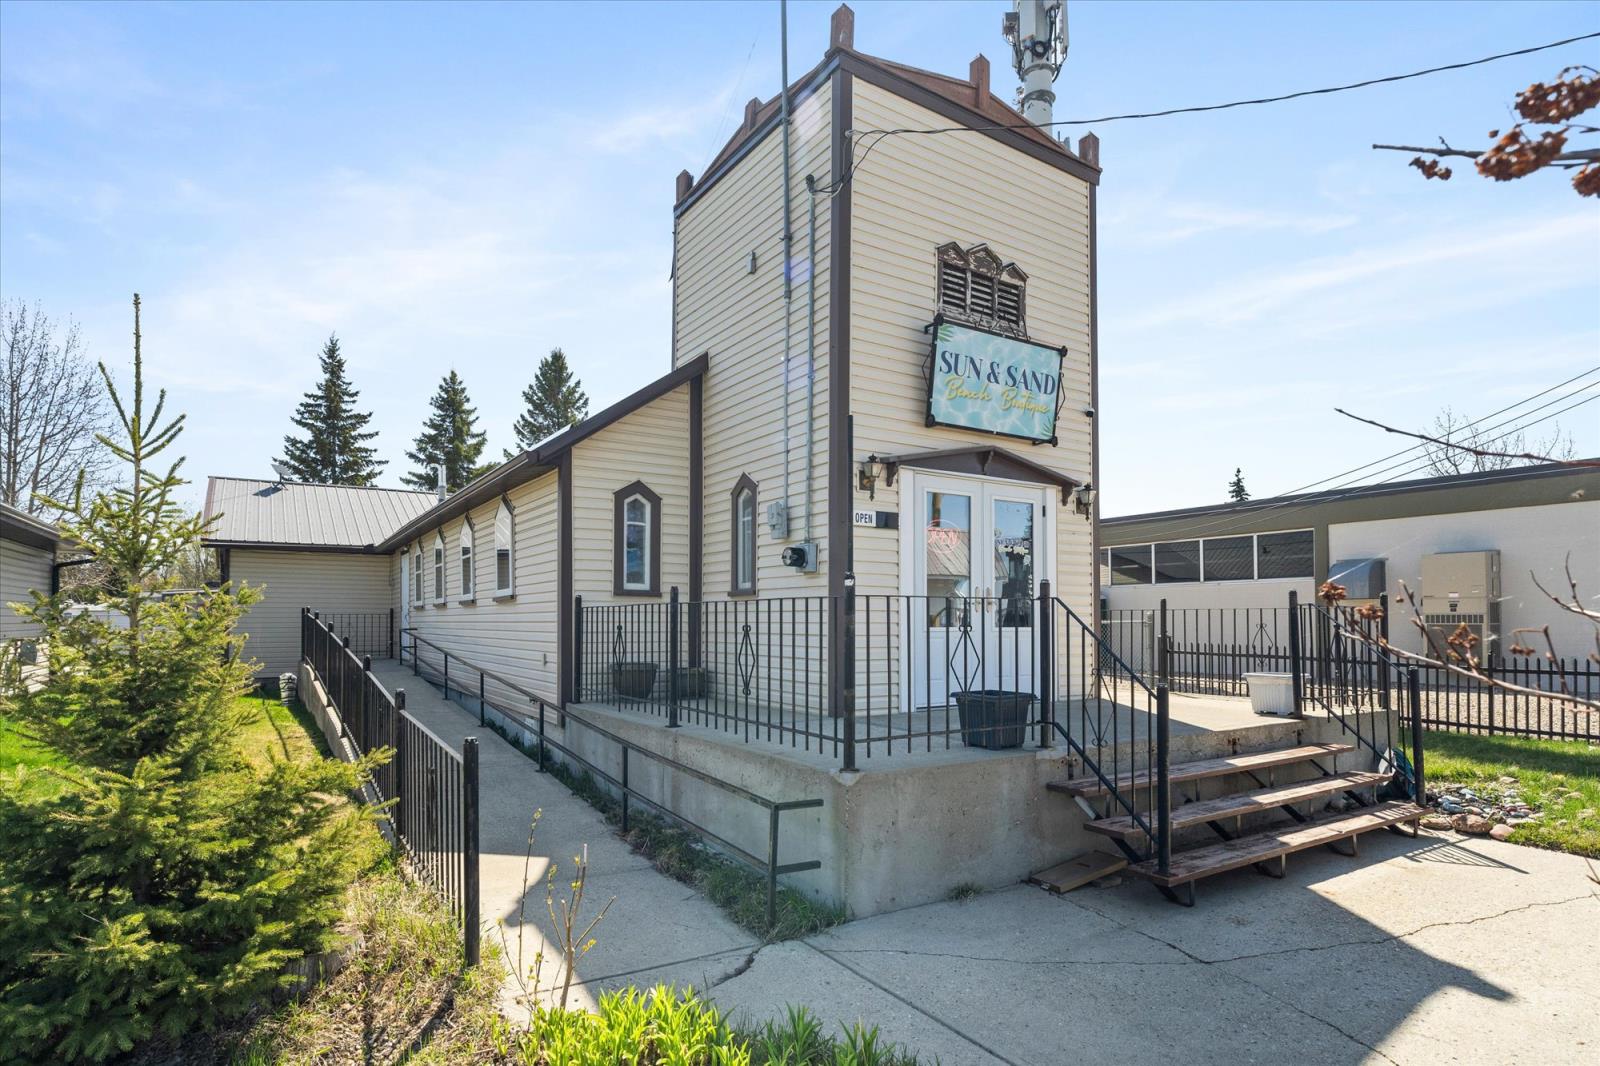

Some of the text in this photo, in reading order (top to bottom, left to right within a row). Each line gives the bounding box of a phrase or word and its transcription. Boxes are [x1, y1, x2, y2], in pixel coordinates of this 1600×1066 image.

[940, 350, 1056, 395] SUN & SAND
[944, 376, 992, 400] Beach
[855, 512, 873, 524] OPEN
